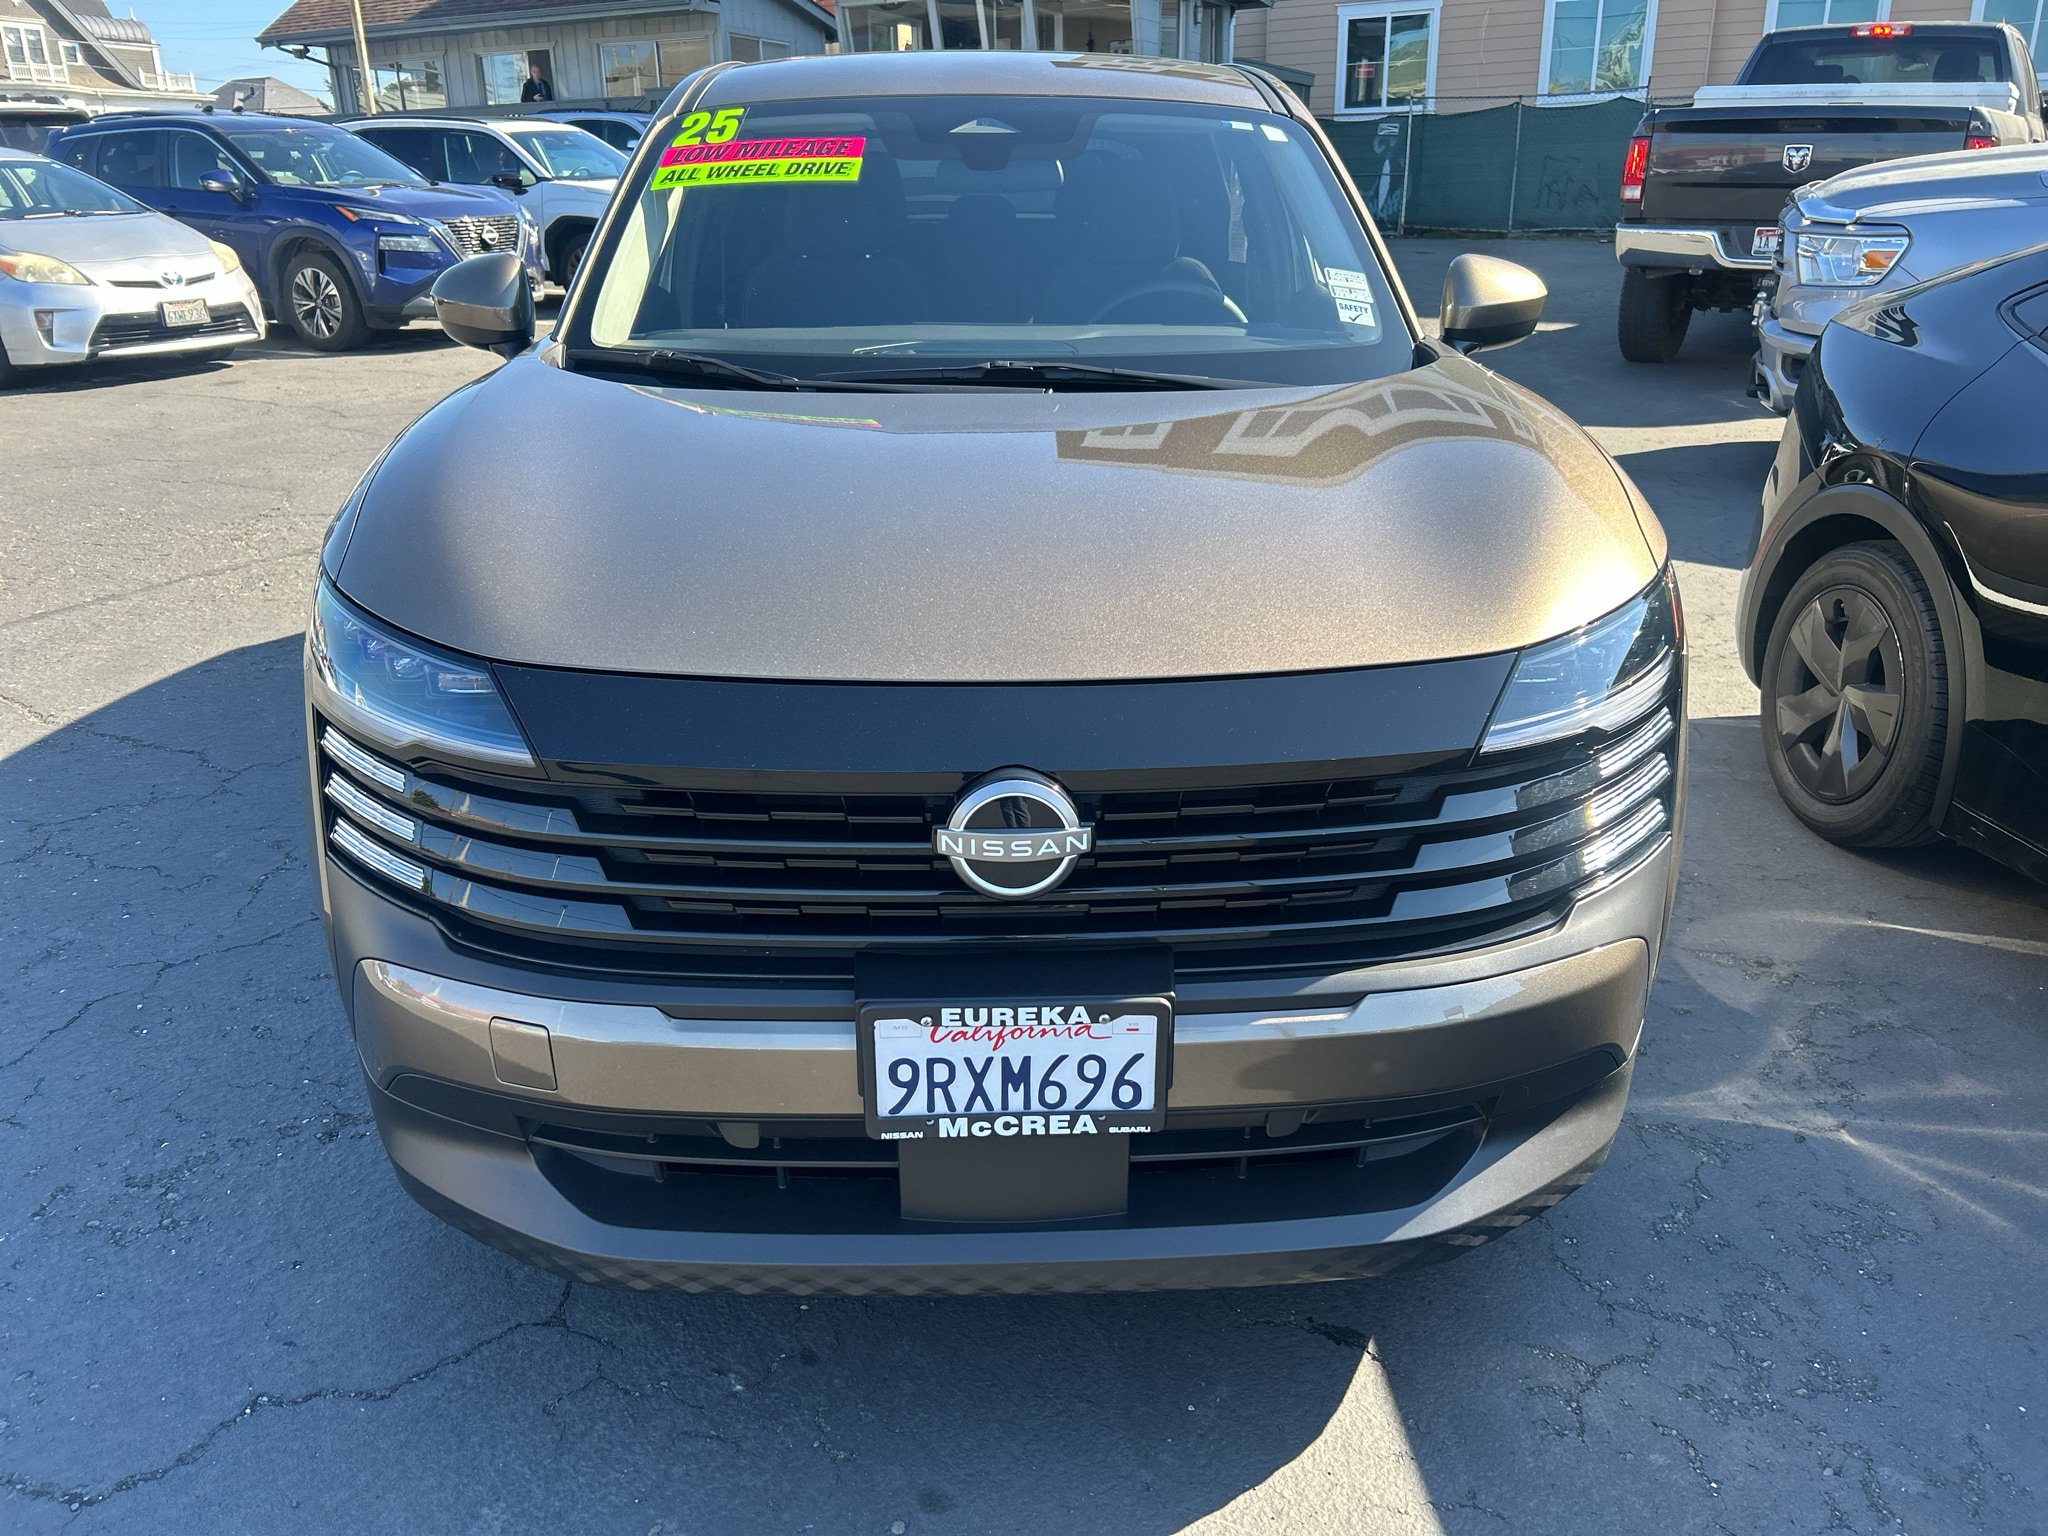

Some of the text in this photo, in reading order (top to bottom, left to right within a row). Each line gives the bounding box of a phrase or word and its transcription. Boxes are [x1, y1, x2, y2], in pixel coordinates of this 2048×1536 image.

[674, 109, 744, 147] 25
[671, 140, 853, 164] LOW MILEAGE
[659, 161, 852, 184] ALL WHEEL DRIVE
[1338, 302, 1368, 314] SAFETY
[940, 833, 1088, 857] NISSAN
[941, 1006, 1092, 1026] EUREKA
[929, 1024, 1112, 1051] California
[888, 1053, 1145, 1115] 9RXM696
[880, 1131, 924, 1140] NISSAN
[938, 1114, 1098, 1138] McCREA
